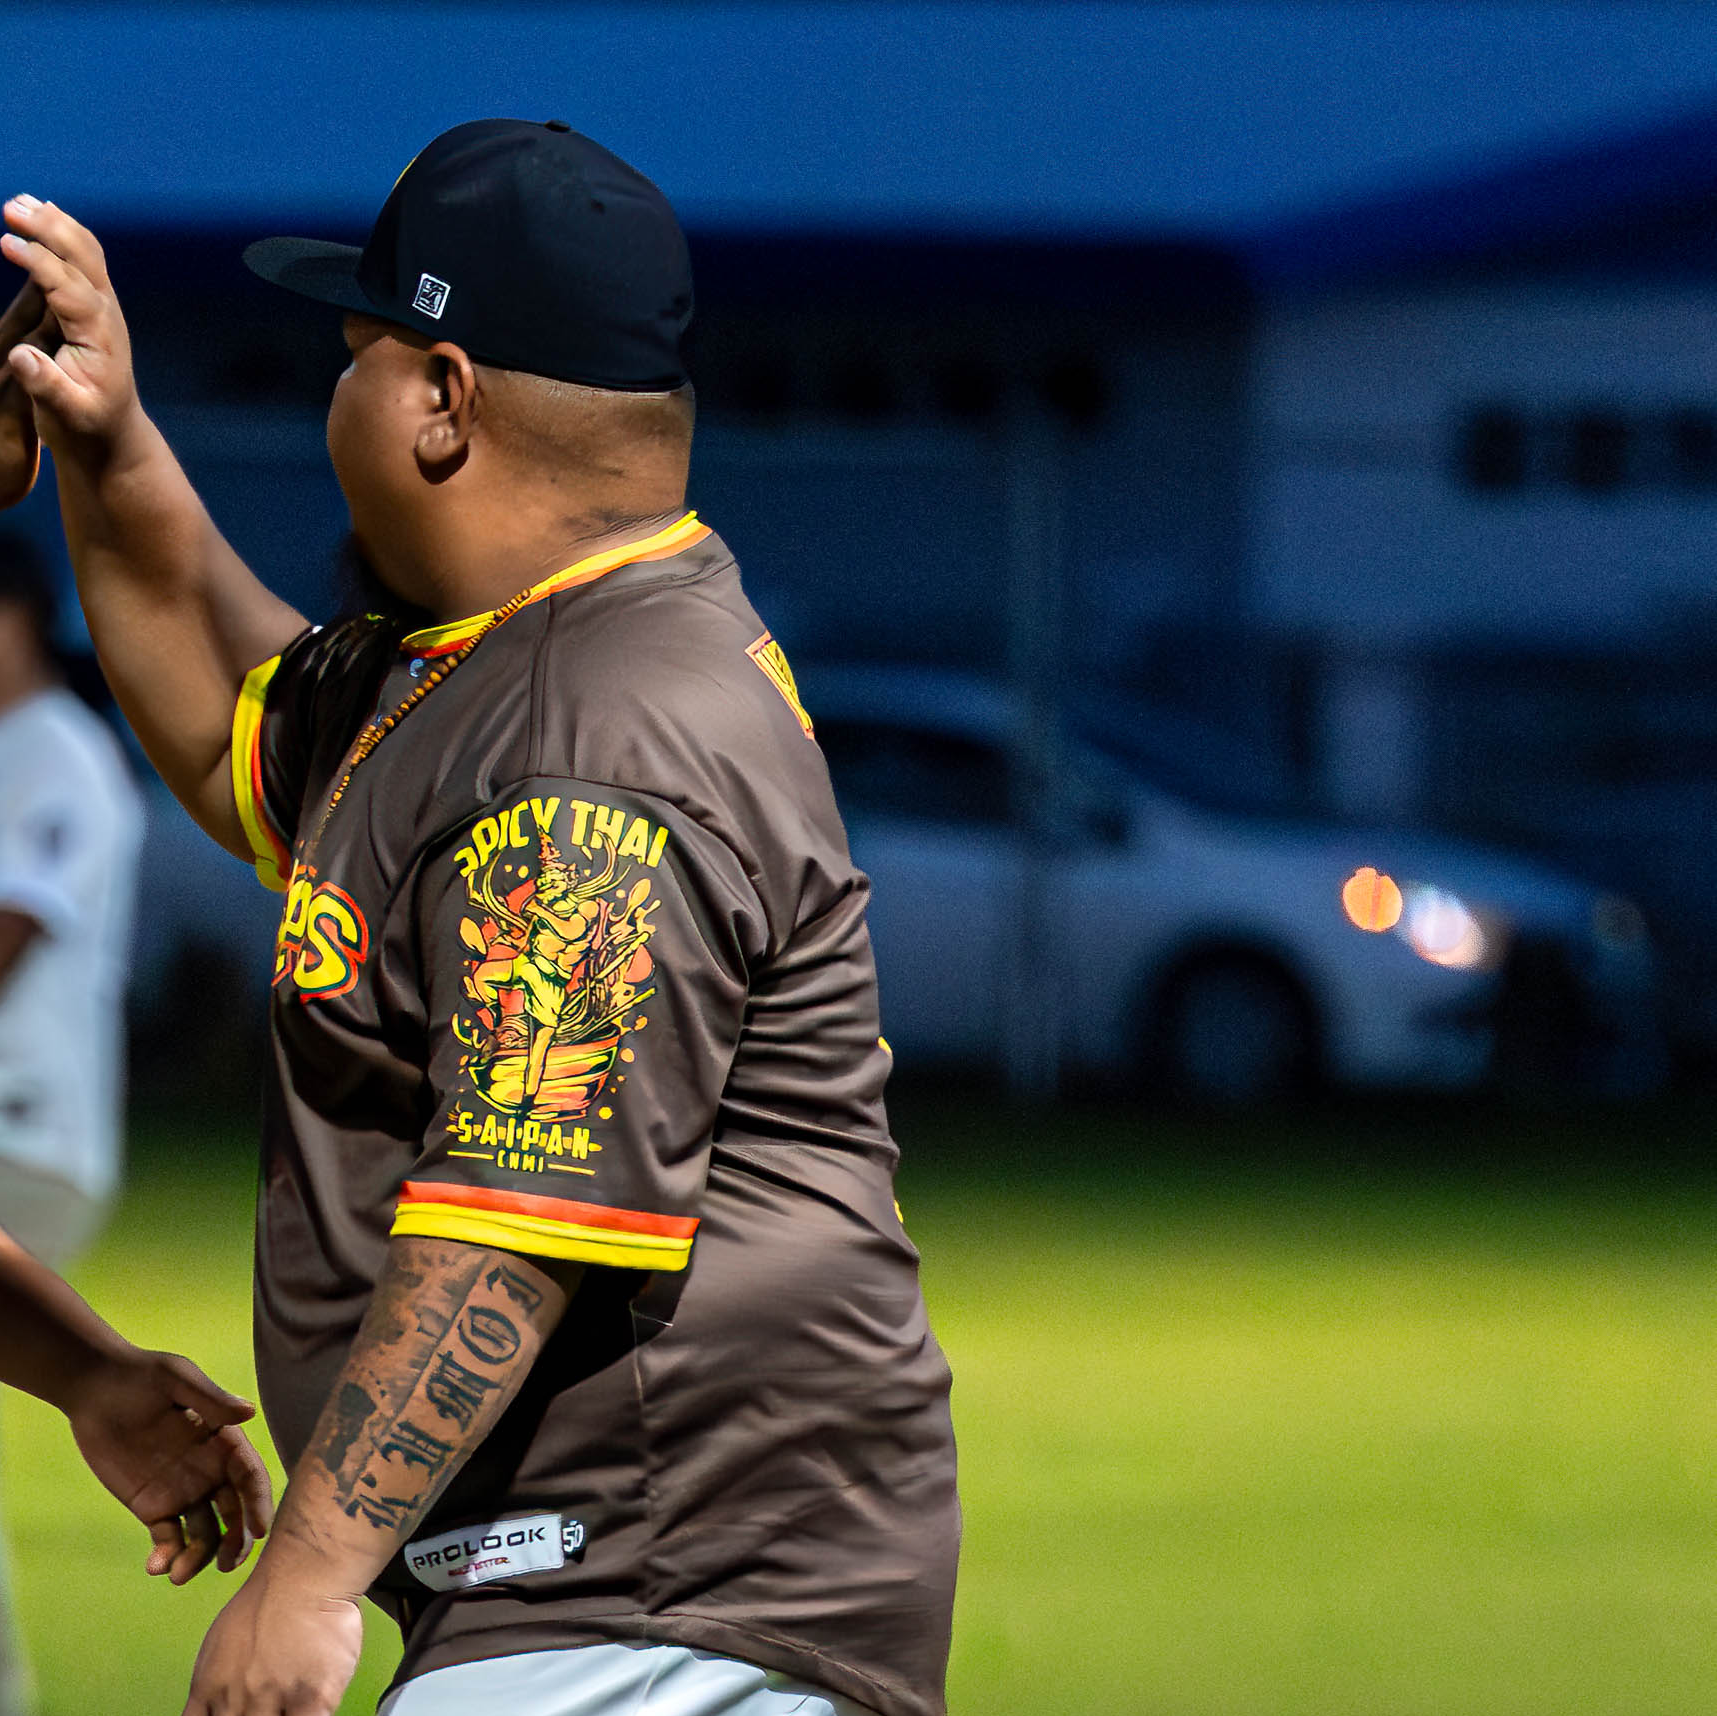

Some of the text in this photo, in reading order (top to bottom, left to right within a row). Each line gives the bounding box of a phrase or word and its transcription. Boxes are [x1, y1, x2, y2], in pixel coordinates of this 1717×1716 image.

[570, 799, 669, 868] THAI
[496, 1149, 544, 1173] CNMI
[411, 1526, 546, 1571] PROLOOK
